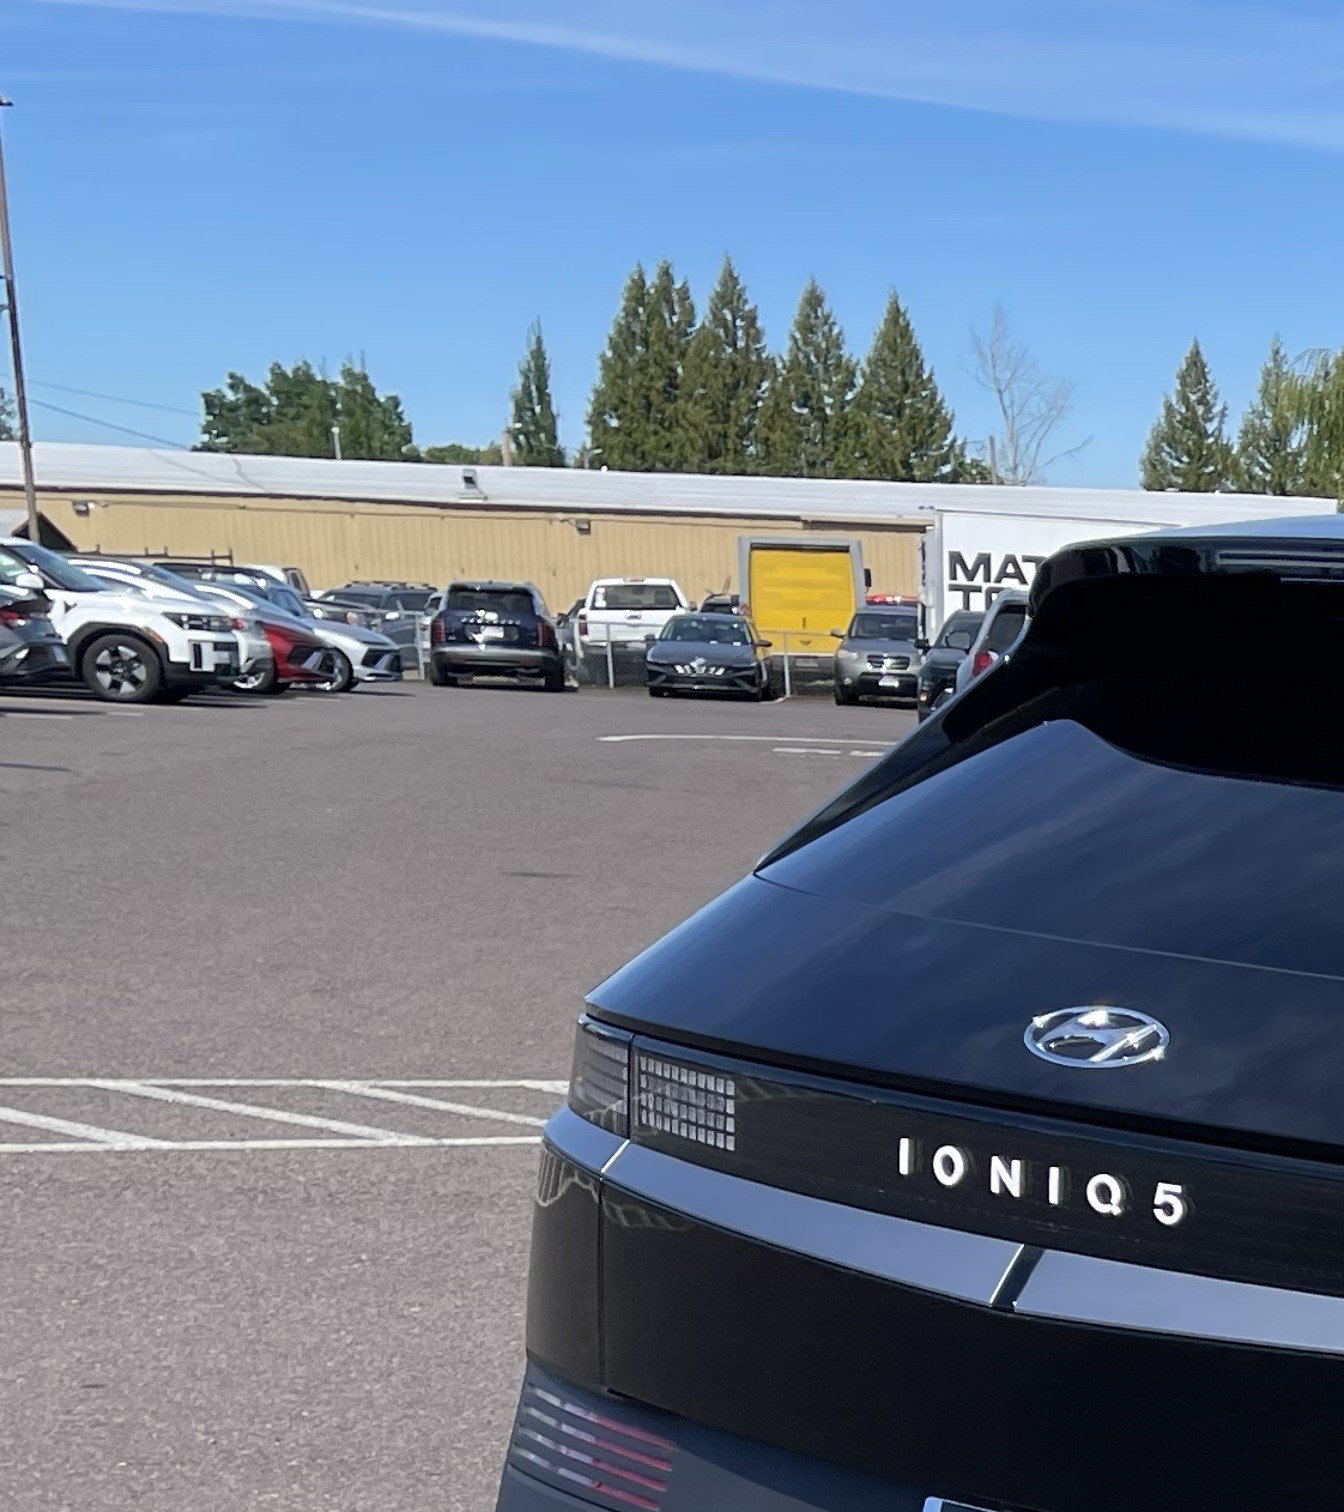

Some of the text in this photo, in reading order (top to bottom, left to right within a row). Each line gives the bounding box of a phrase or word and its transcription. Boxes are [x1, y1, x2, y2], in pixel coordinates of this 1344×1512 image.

[948, 550, 1049, 585] MAT
[899, 1137, 1188, 1227] IONIQ 5
